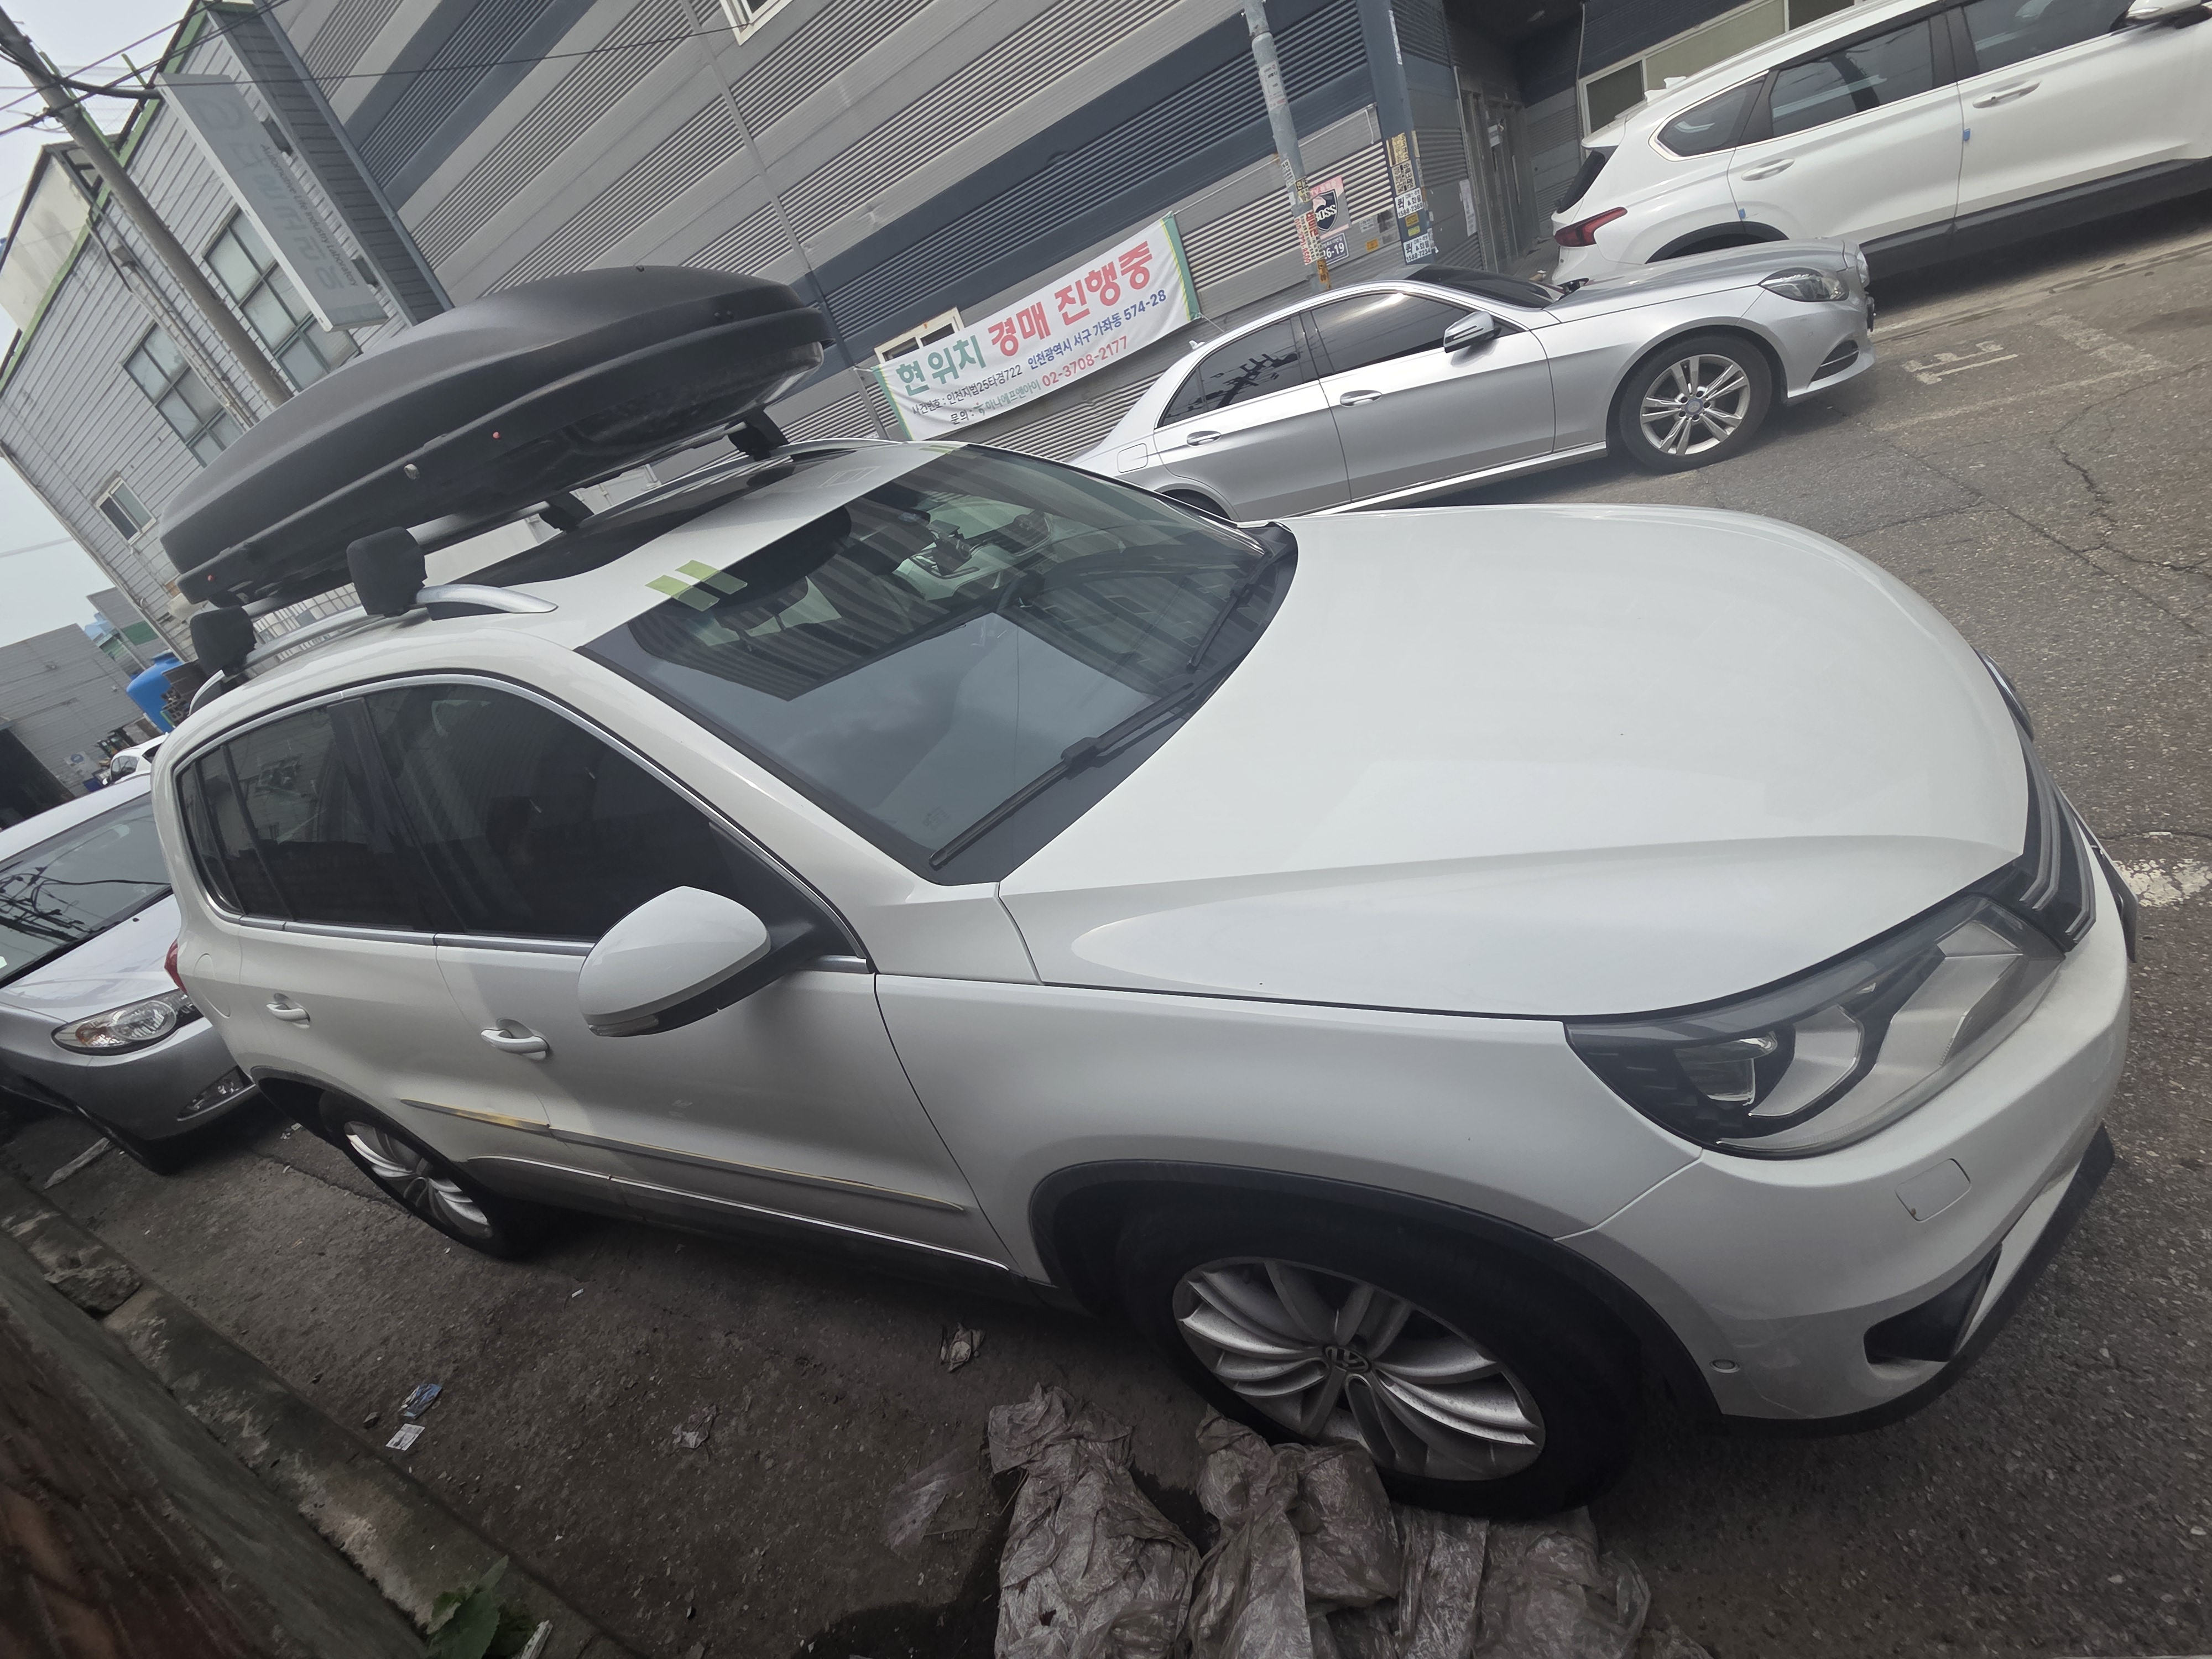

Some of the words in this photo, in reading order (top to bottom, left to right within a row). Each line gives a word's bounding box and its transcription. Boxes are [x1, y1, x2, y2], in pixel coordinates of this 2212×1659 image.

[260, 144, 297, 195] Automotive
[295, 195, 309, 211] Life
[306, 211, 328, 245] Industry
[328, 244, 358, 287] Laboratory
[988, 301, 1051, 357] 경매
[1054, 241, 1153, 326] 진행중
[1027, 338, 1073, 370] 인천광역시
[1074, 328, 1092, 346] 서구
[1093, 312, 1122, 336] 가좌동
[1123, 289, 1166, 320] 574-28
[947, 364, 1023, 405] 인천지법25타경722
[1042, 335, 1127, 387] 02-3708-2177
